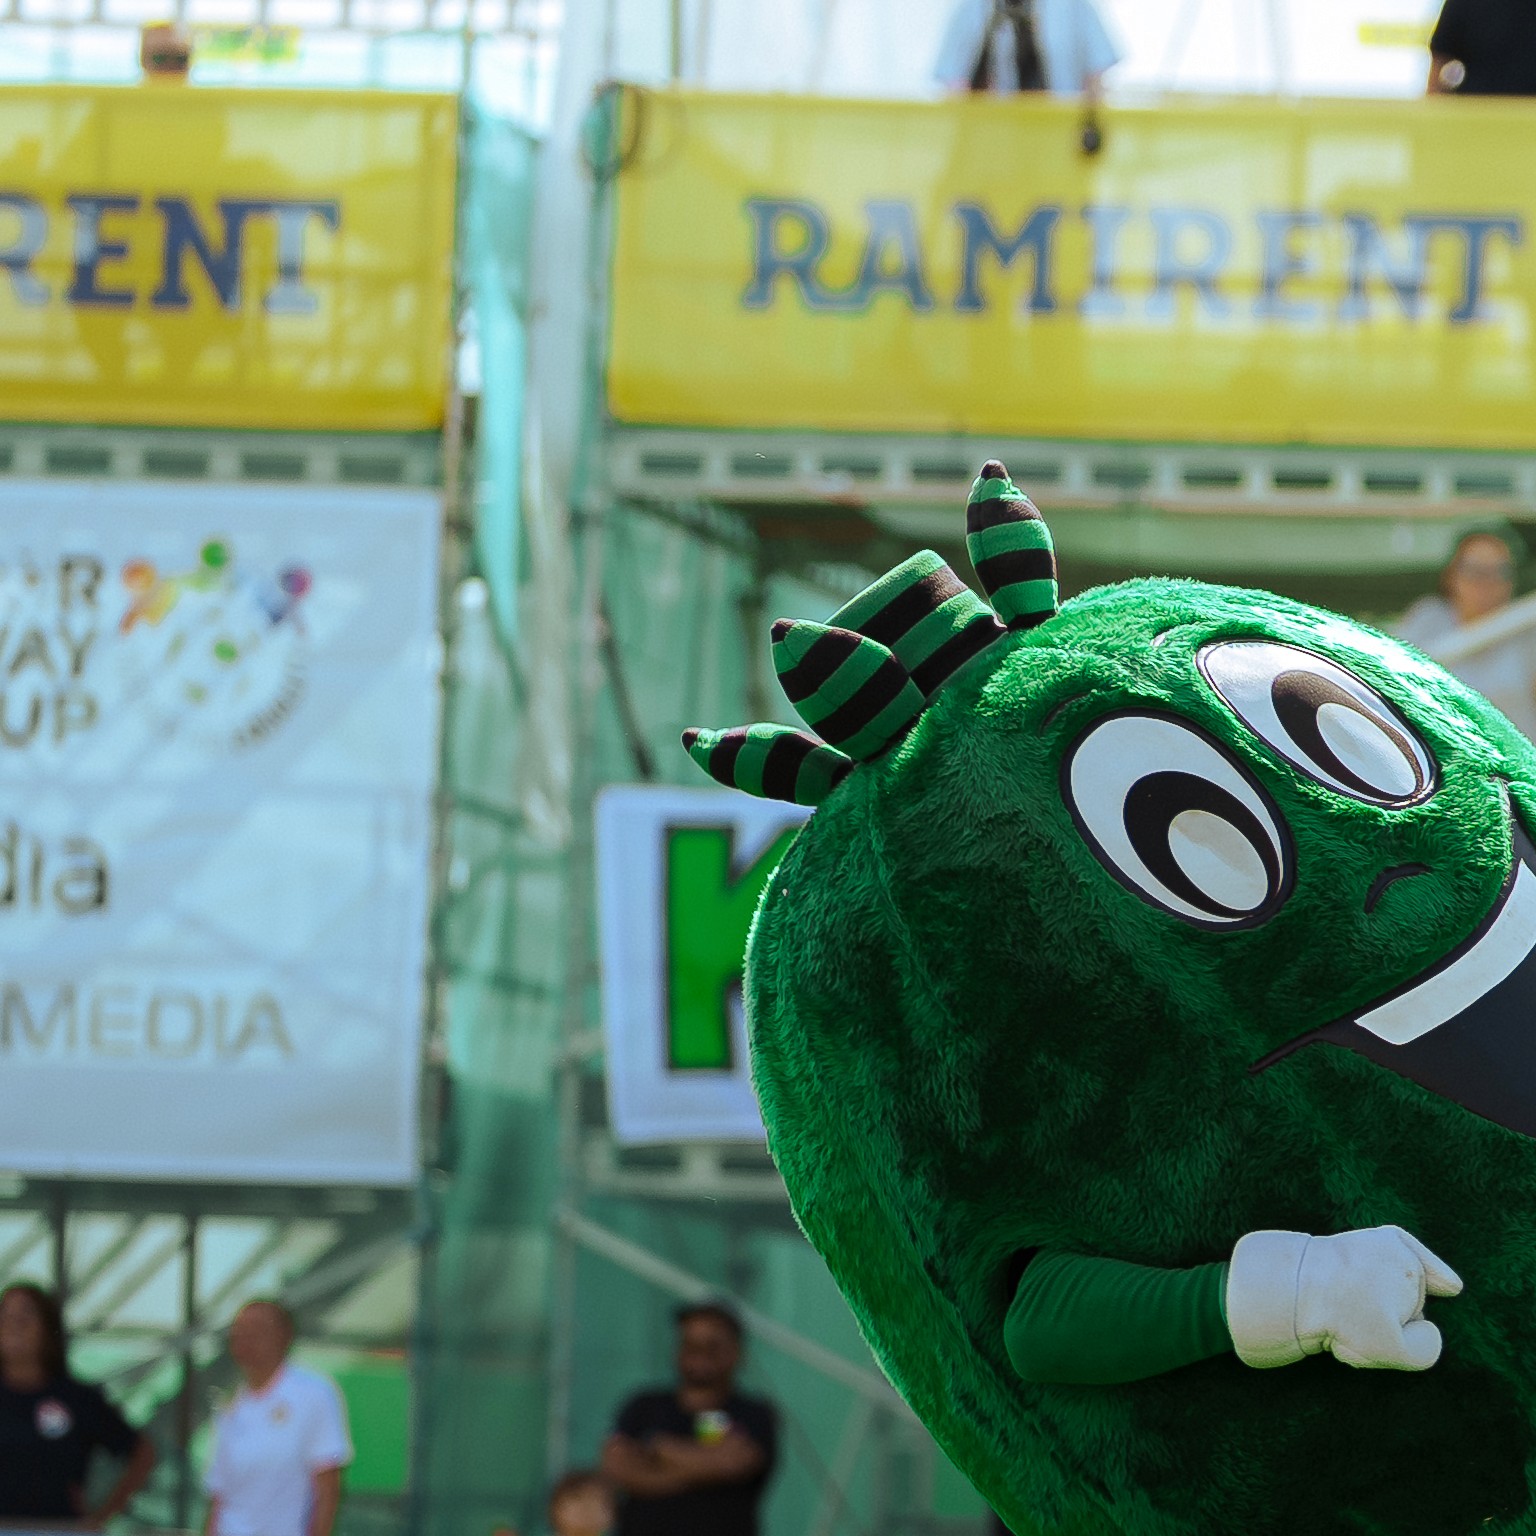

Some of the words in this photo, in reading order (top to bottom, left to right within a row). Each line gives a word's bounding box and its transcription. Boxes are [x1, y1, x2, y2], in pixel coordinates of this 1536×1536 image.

[742, 199, 1522, 323] RAMIRENT
[0, 624, 97, 678] AY
[0, 983, 296, 1058] MEDIA
